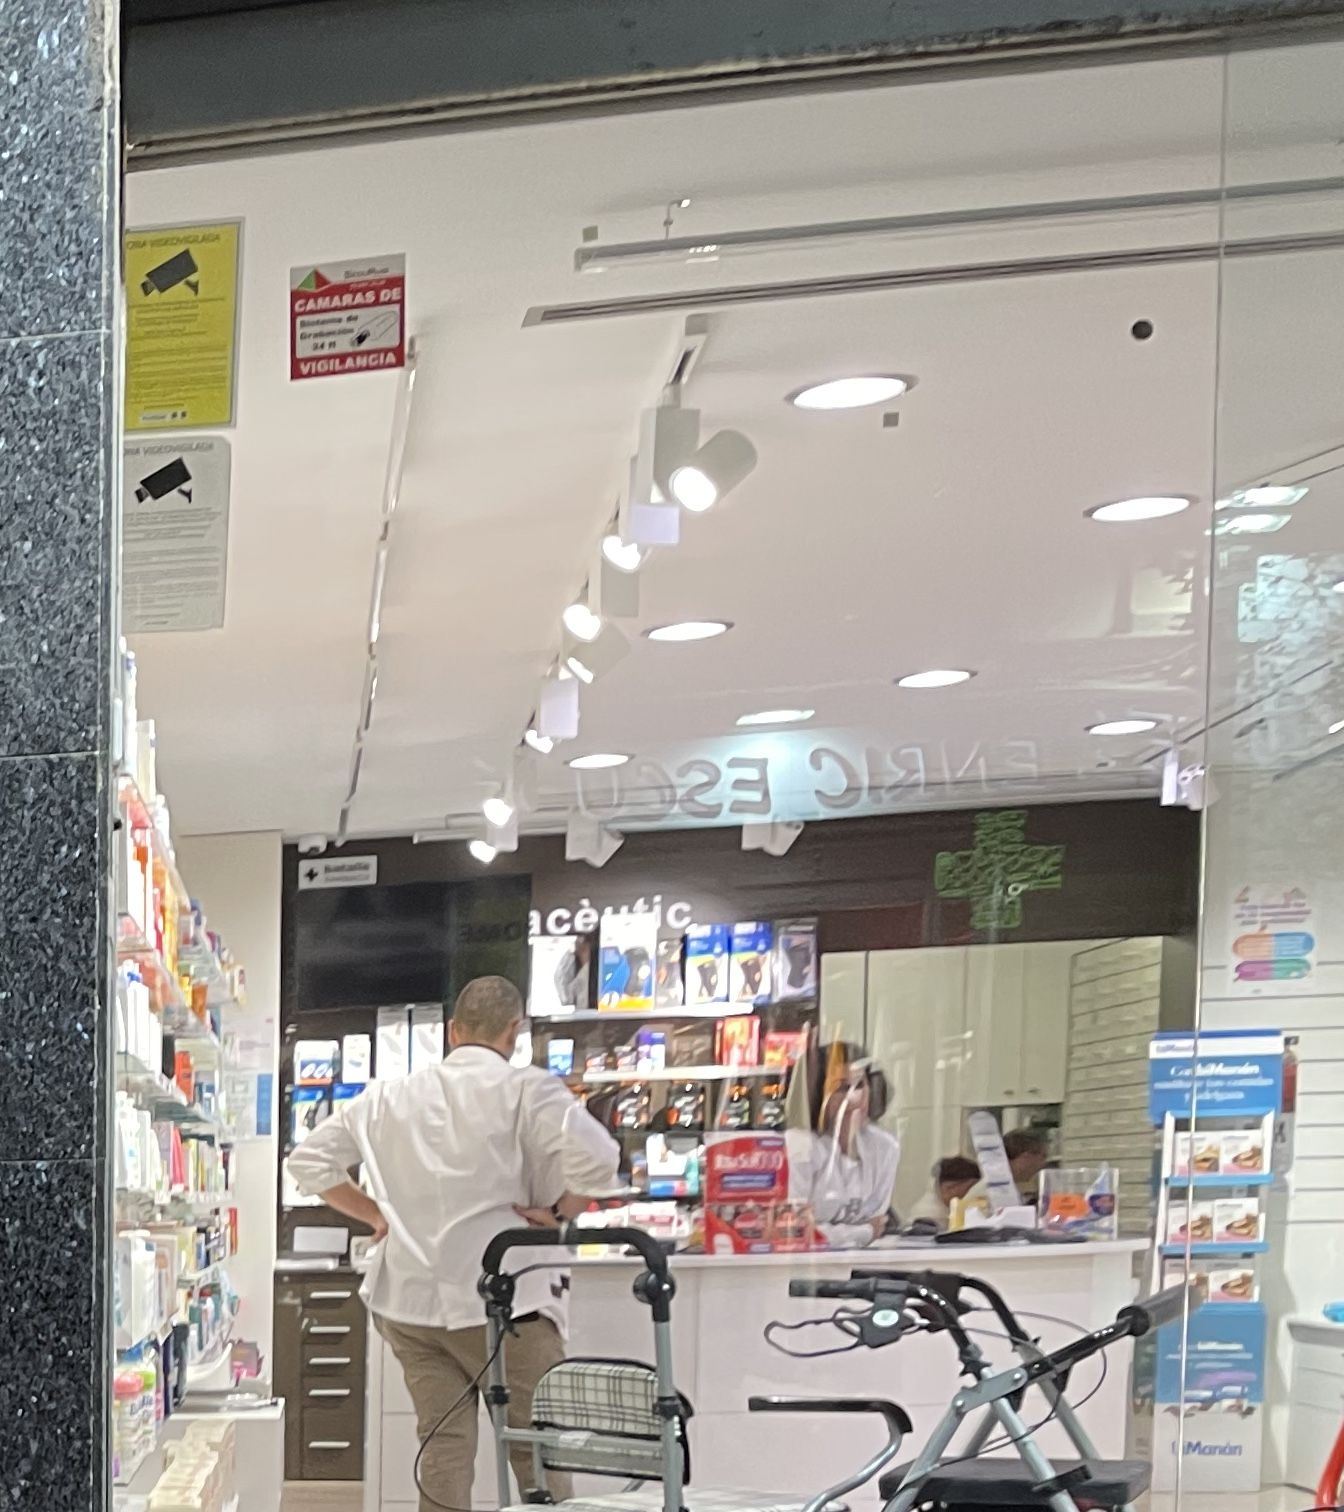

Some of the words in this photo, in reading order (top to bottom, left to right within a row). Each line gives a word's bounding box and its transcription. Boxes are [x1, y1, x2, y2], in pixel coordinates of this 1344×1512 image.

[294, 290, 376, 313] CAMARAS
[379, 287, 402, 303] DE
[300, 352, 397, 375] VIGILANCIA
